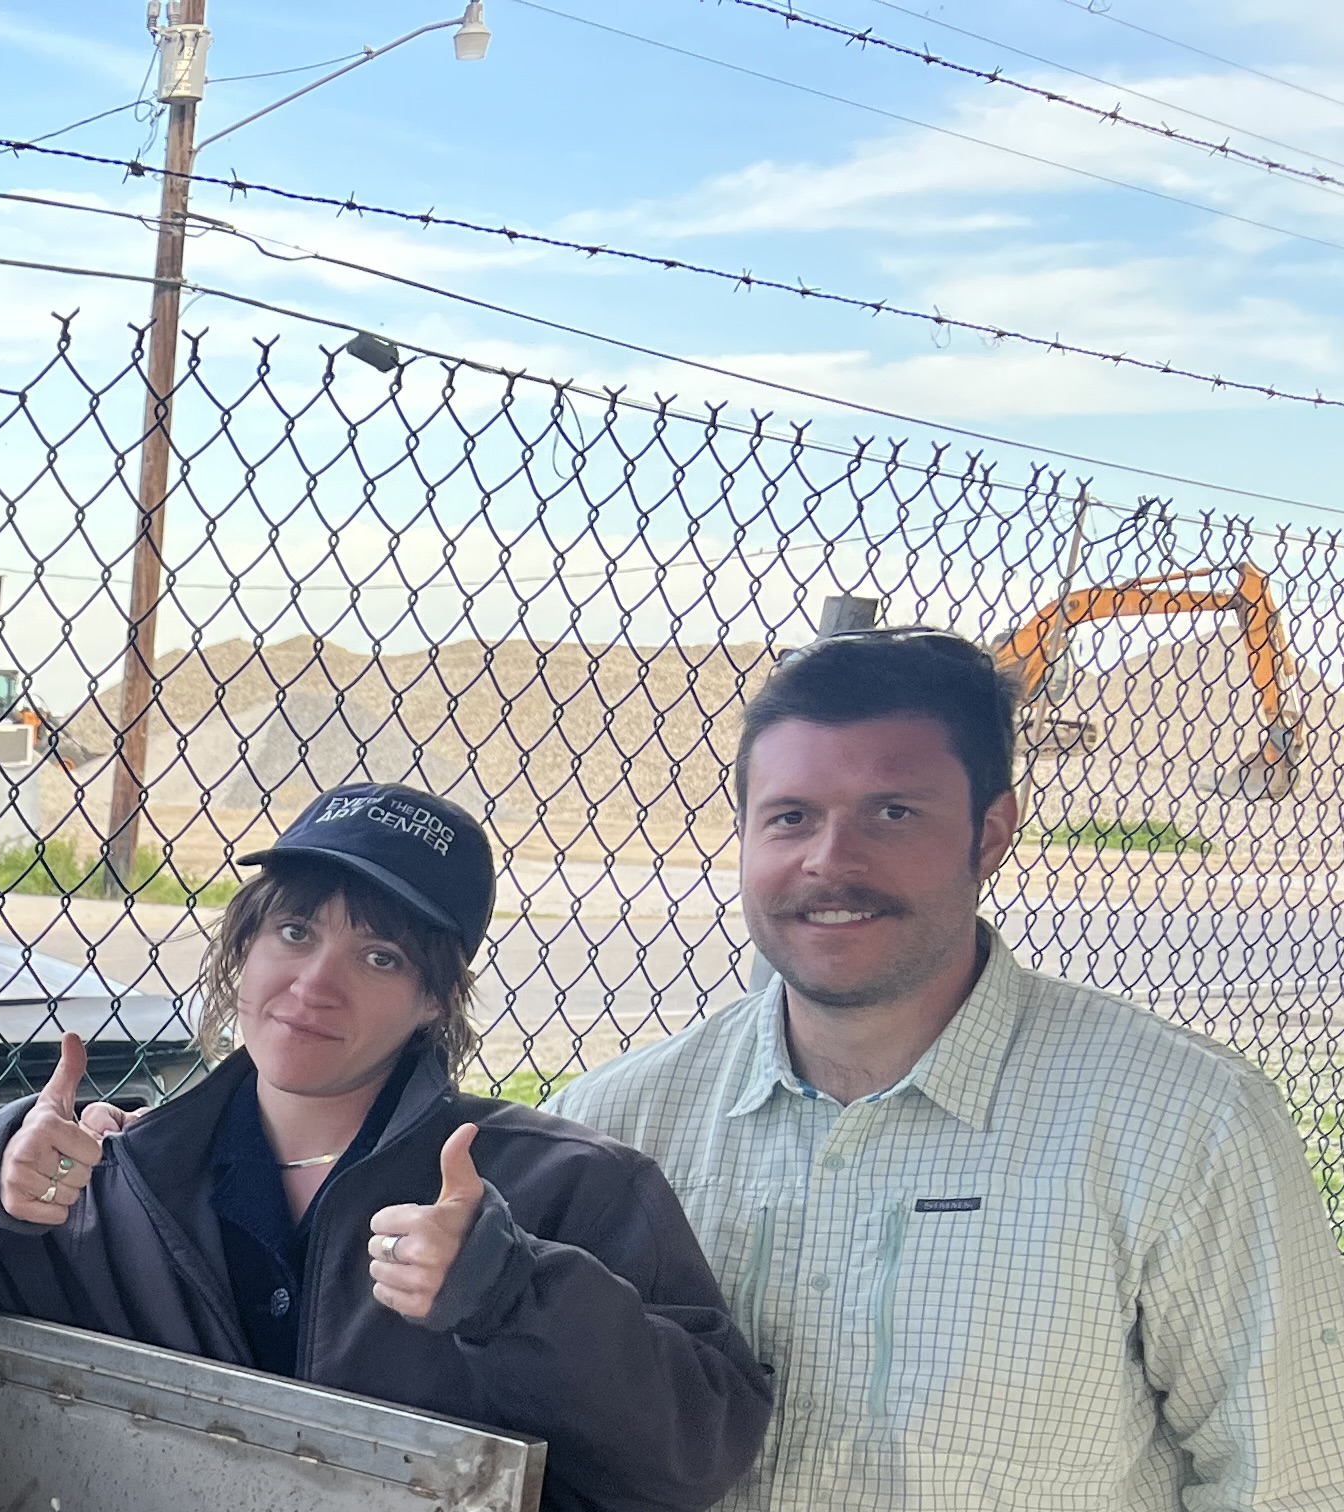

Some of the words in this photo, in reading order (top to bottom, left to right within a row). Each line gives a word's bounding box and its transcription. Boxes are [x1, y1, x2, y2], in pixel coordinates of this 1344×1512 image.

[325, 797, 370, 811] EYE
[390, 799, 415, 815] THE
[412, 807, 455, 843] DOG
[367, 806, 449, 857] CENTER
